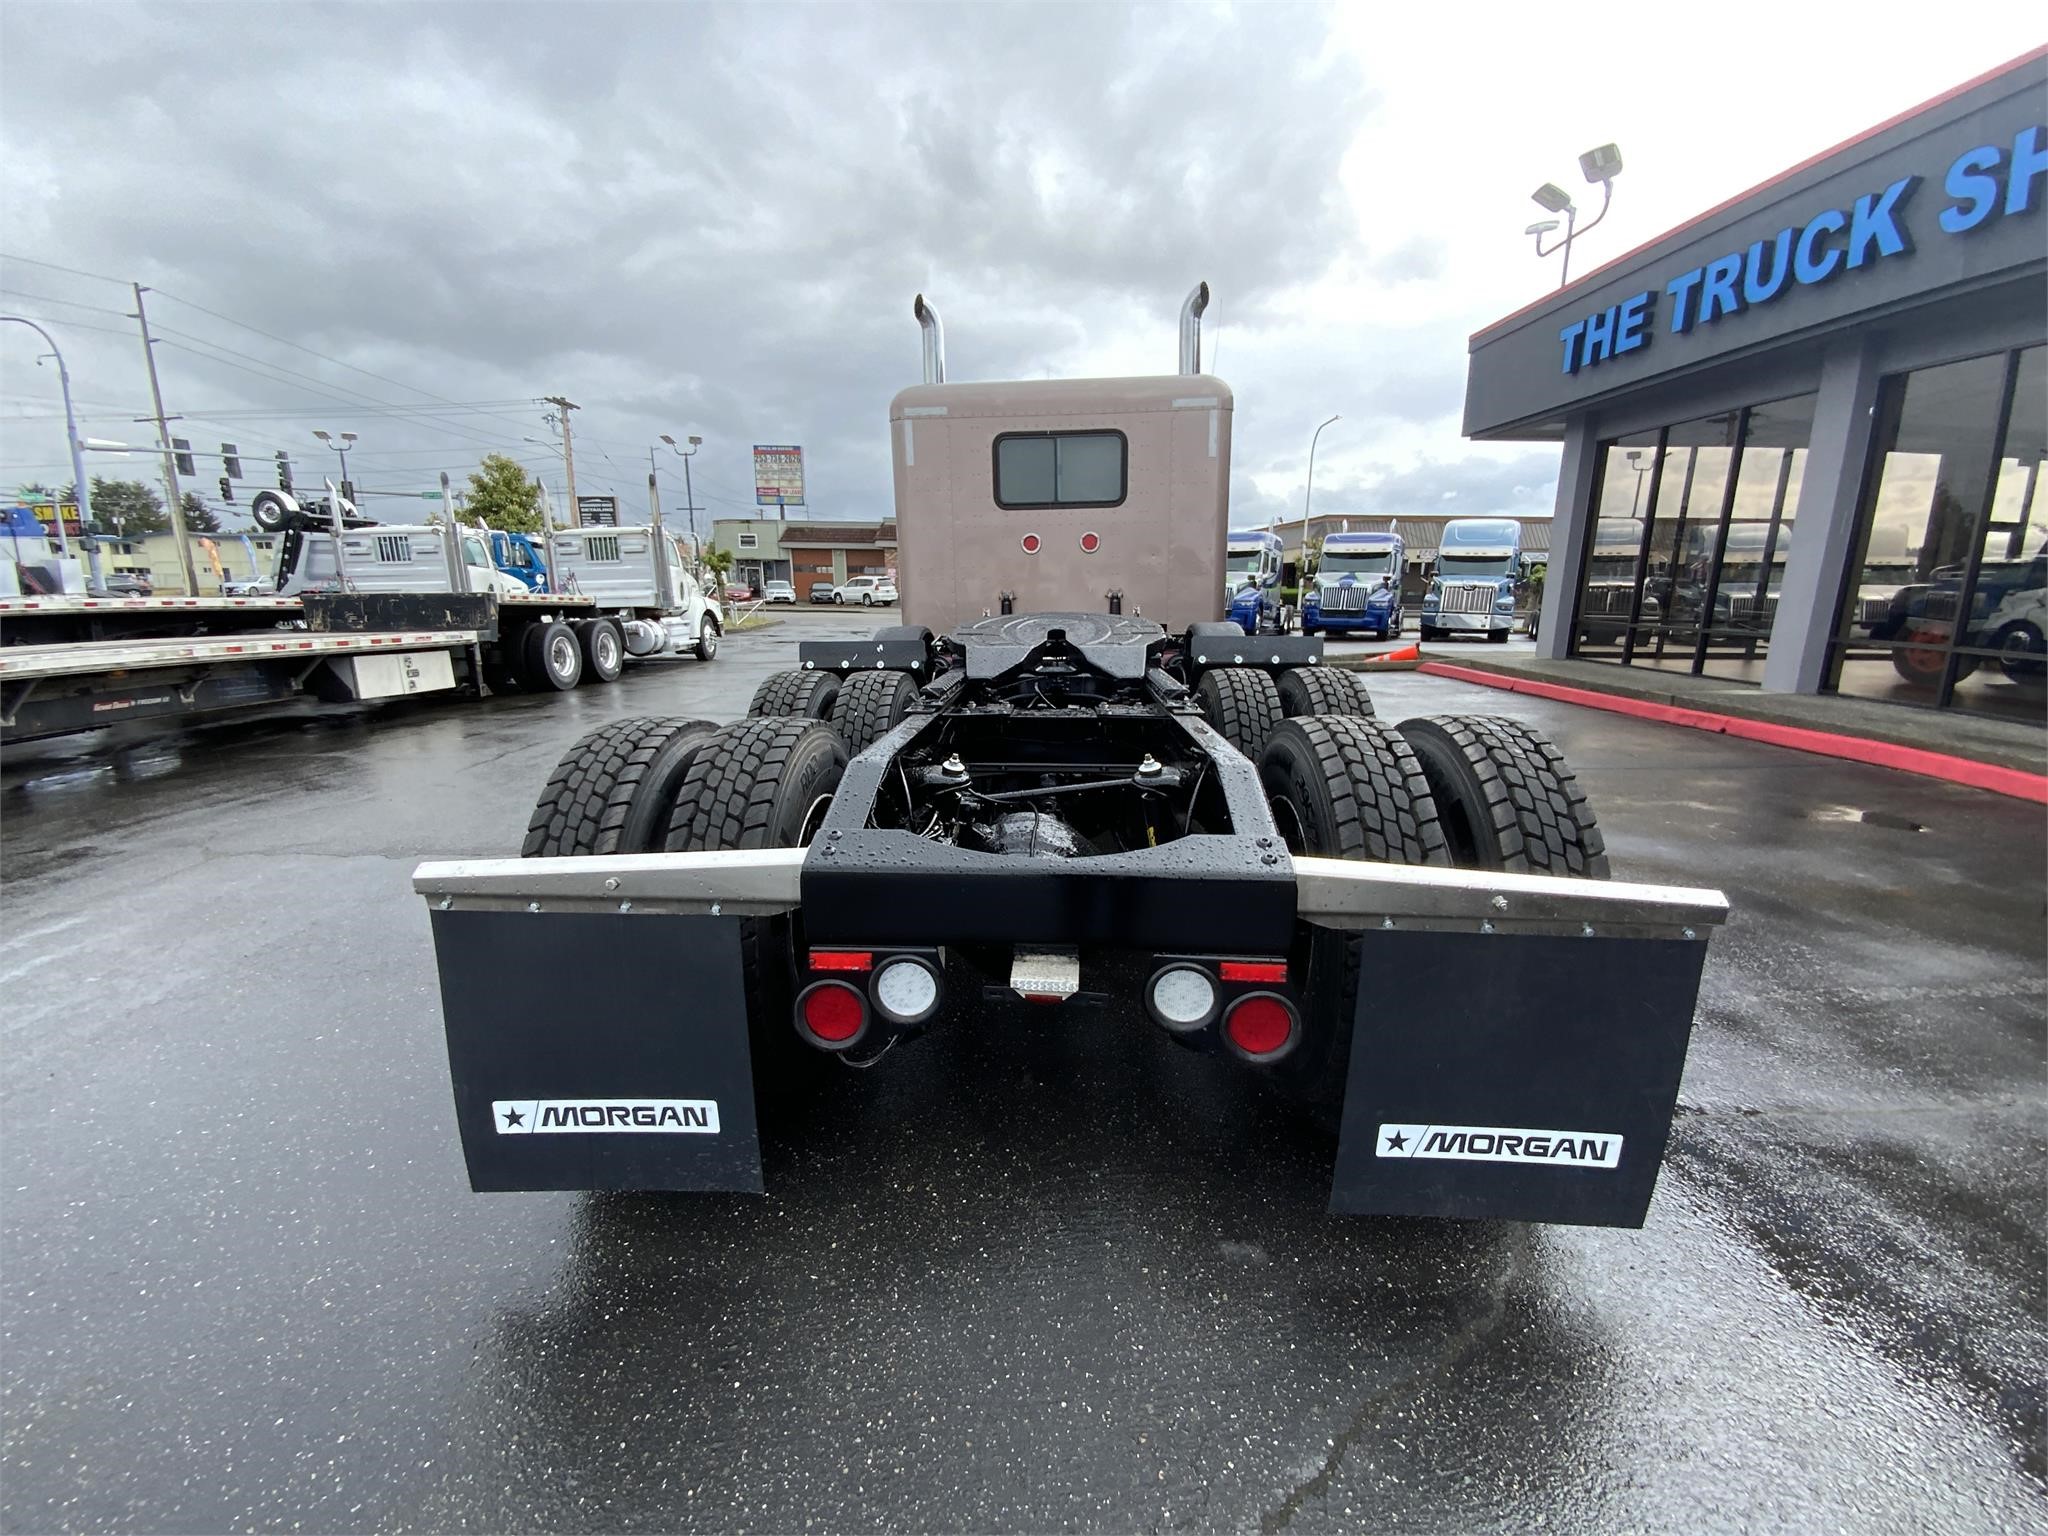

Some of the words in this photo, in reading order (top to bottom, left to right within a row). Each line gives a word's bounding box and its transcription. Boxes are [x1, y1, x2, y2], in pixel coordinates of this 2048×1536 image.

[1560, 291, 1650, 374] THE
[1666, 175, 1916, 333] TRUCK
[34, 506, 79, 520] SMKE
[541, 1106, 709, 1127] MORGAN
[1423, 1132, 1609, 1161] MORGAN
